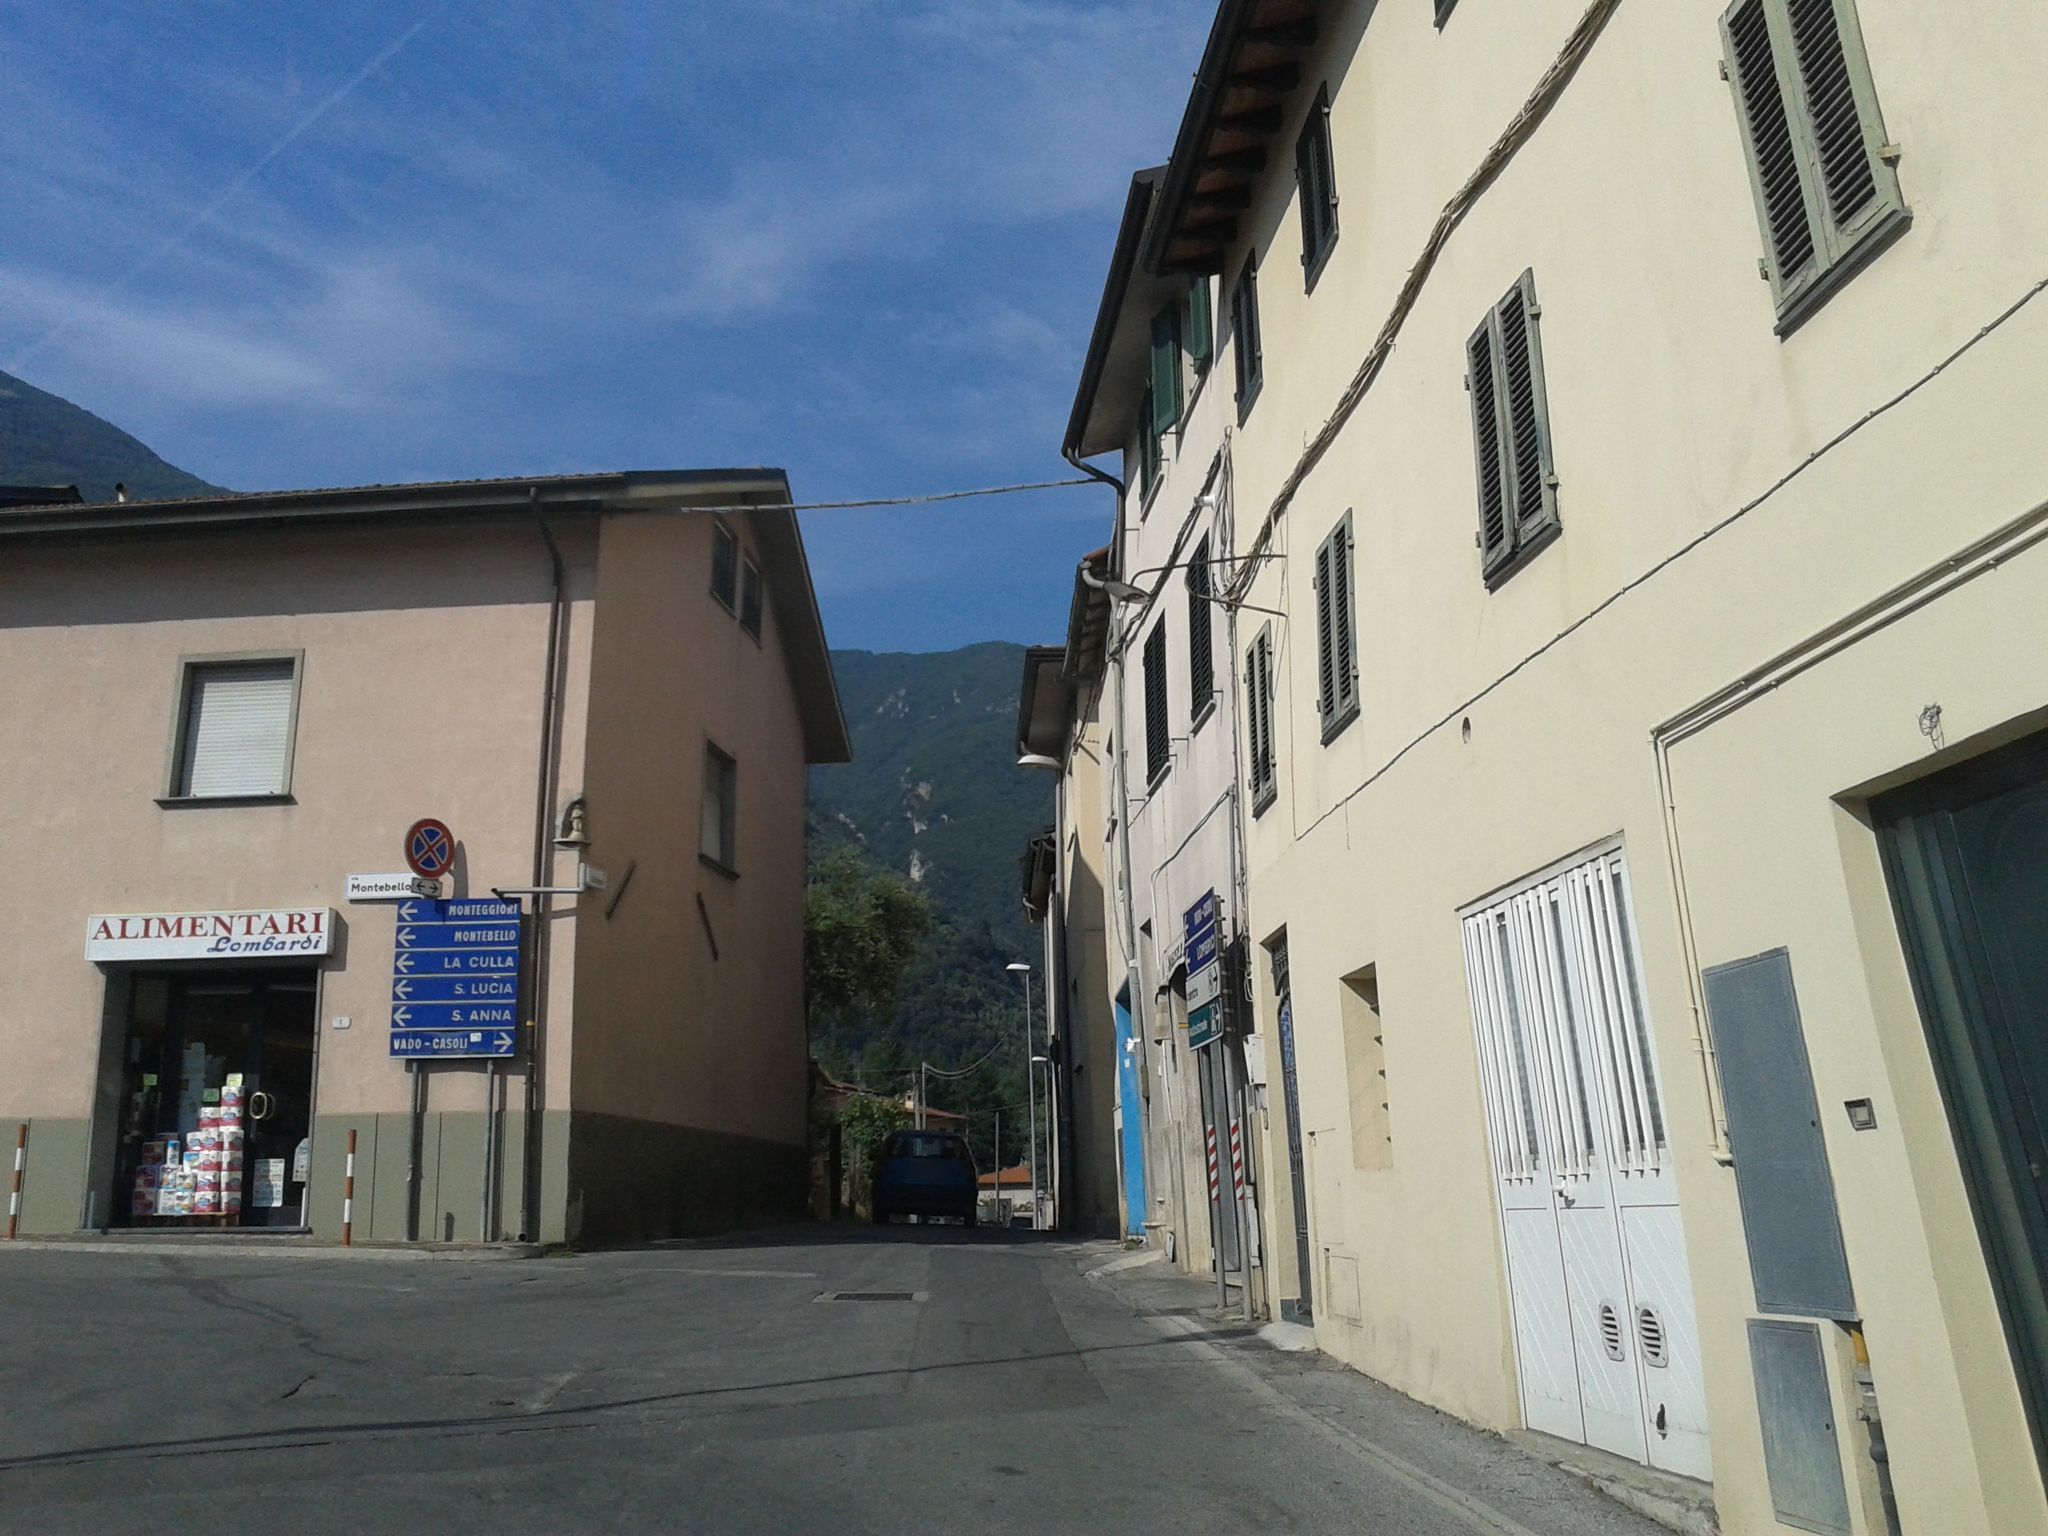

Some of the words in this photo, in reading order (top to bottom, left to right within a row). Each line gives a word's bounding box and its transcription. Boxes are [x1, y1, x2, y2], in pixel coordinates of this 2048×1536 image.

[351, 882, 411, 893] Montebello
[449, 904, 518, 916] MONTEGGIORI
[92, 912, 325, 940] ALIMENTARI
[454, 930, 516, 942] MONTEBELLO
[207, 935, 322, 953] Lombardi
[444, 957, 461, 969] LA
[469, 956, 515, 969] CULLA
[454, 983, 466, 995] S.
[471, 982, 513, 995] LUCIA
[451, 1010, 464, 1022] S.
[469, 1009, 511, 1021] ANNA
[393, 1037, 422, 1050] VADO
[432, 1037, 468, 1050] CASOLI
